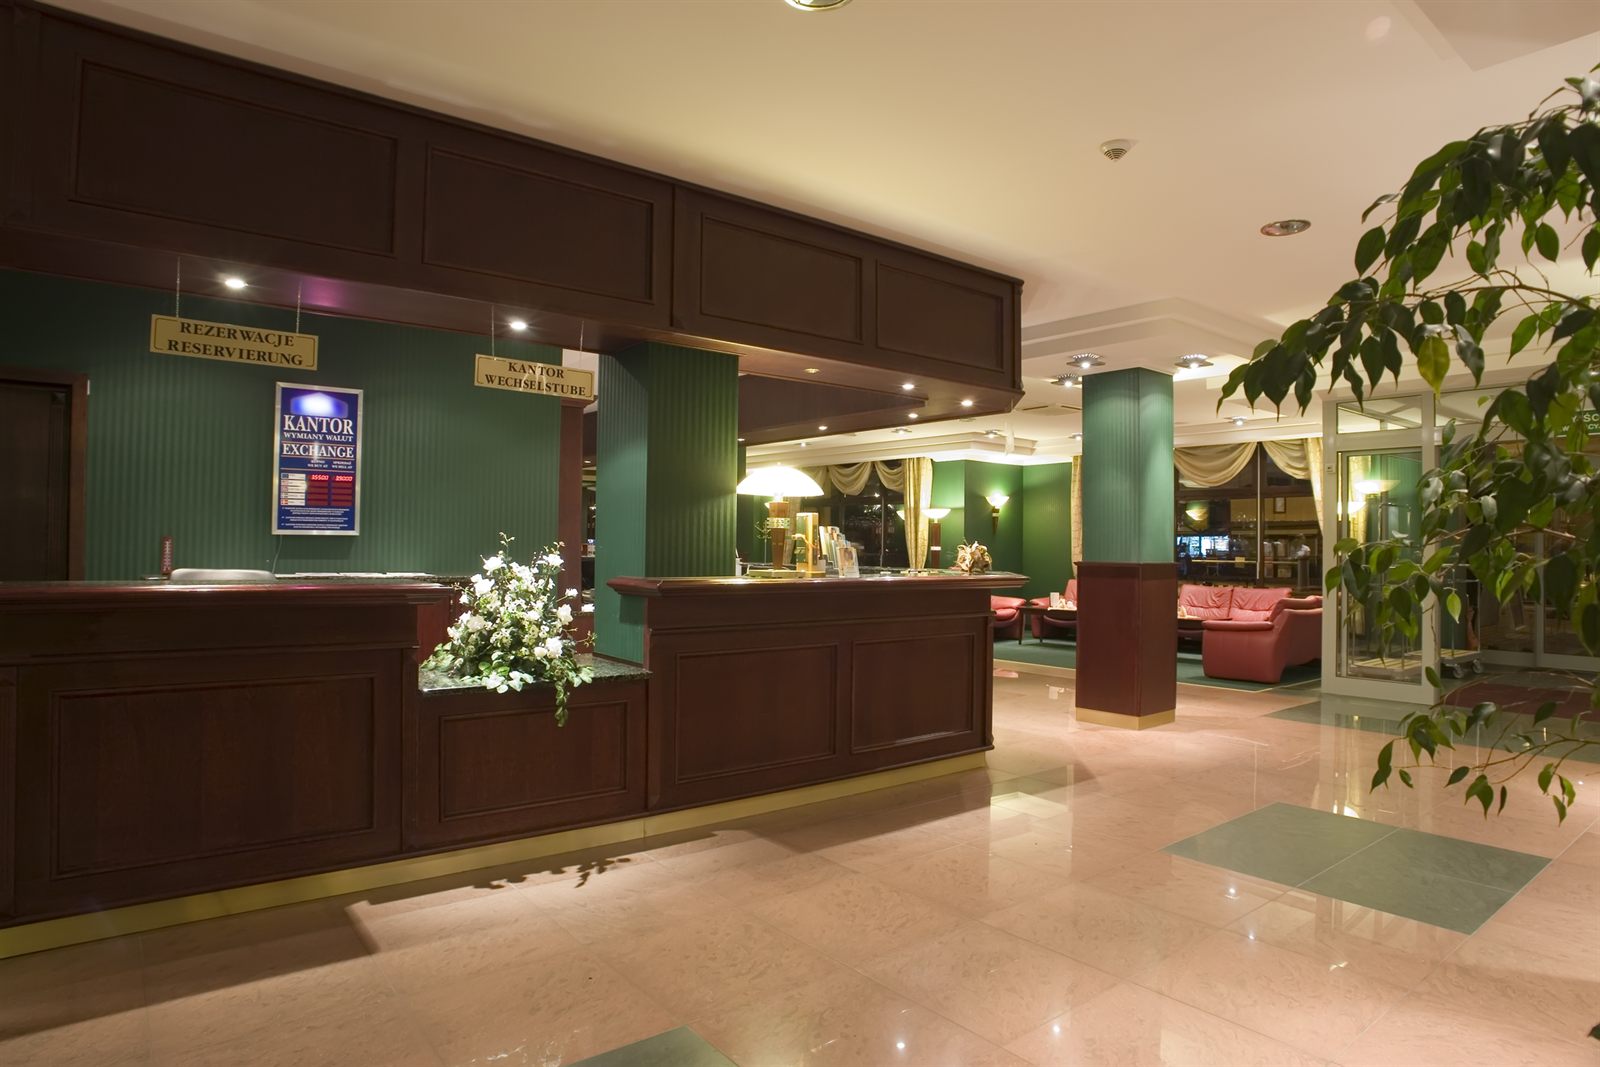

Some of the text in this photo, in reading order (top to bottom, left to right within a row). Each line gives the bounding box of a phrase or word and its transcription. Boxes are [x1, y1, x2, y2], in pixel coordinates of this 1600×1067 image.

[180, 321, 294, 347] REZERWACJE
[167, 339, 303, 366] RESERVIERUNG
[508, 362, 564, 379] KANTOR
[485, 374, 586, 396] WECHSELSTUBE
[283, 415, 354, 435] KANTOR
[283, 432, 354, 442] WYMIANY WALUT
[282, 443, 354, 458] EXCHANGE
